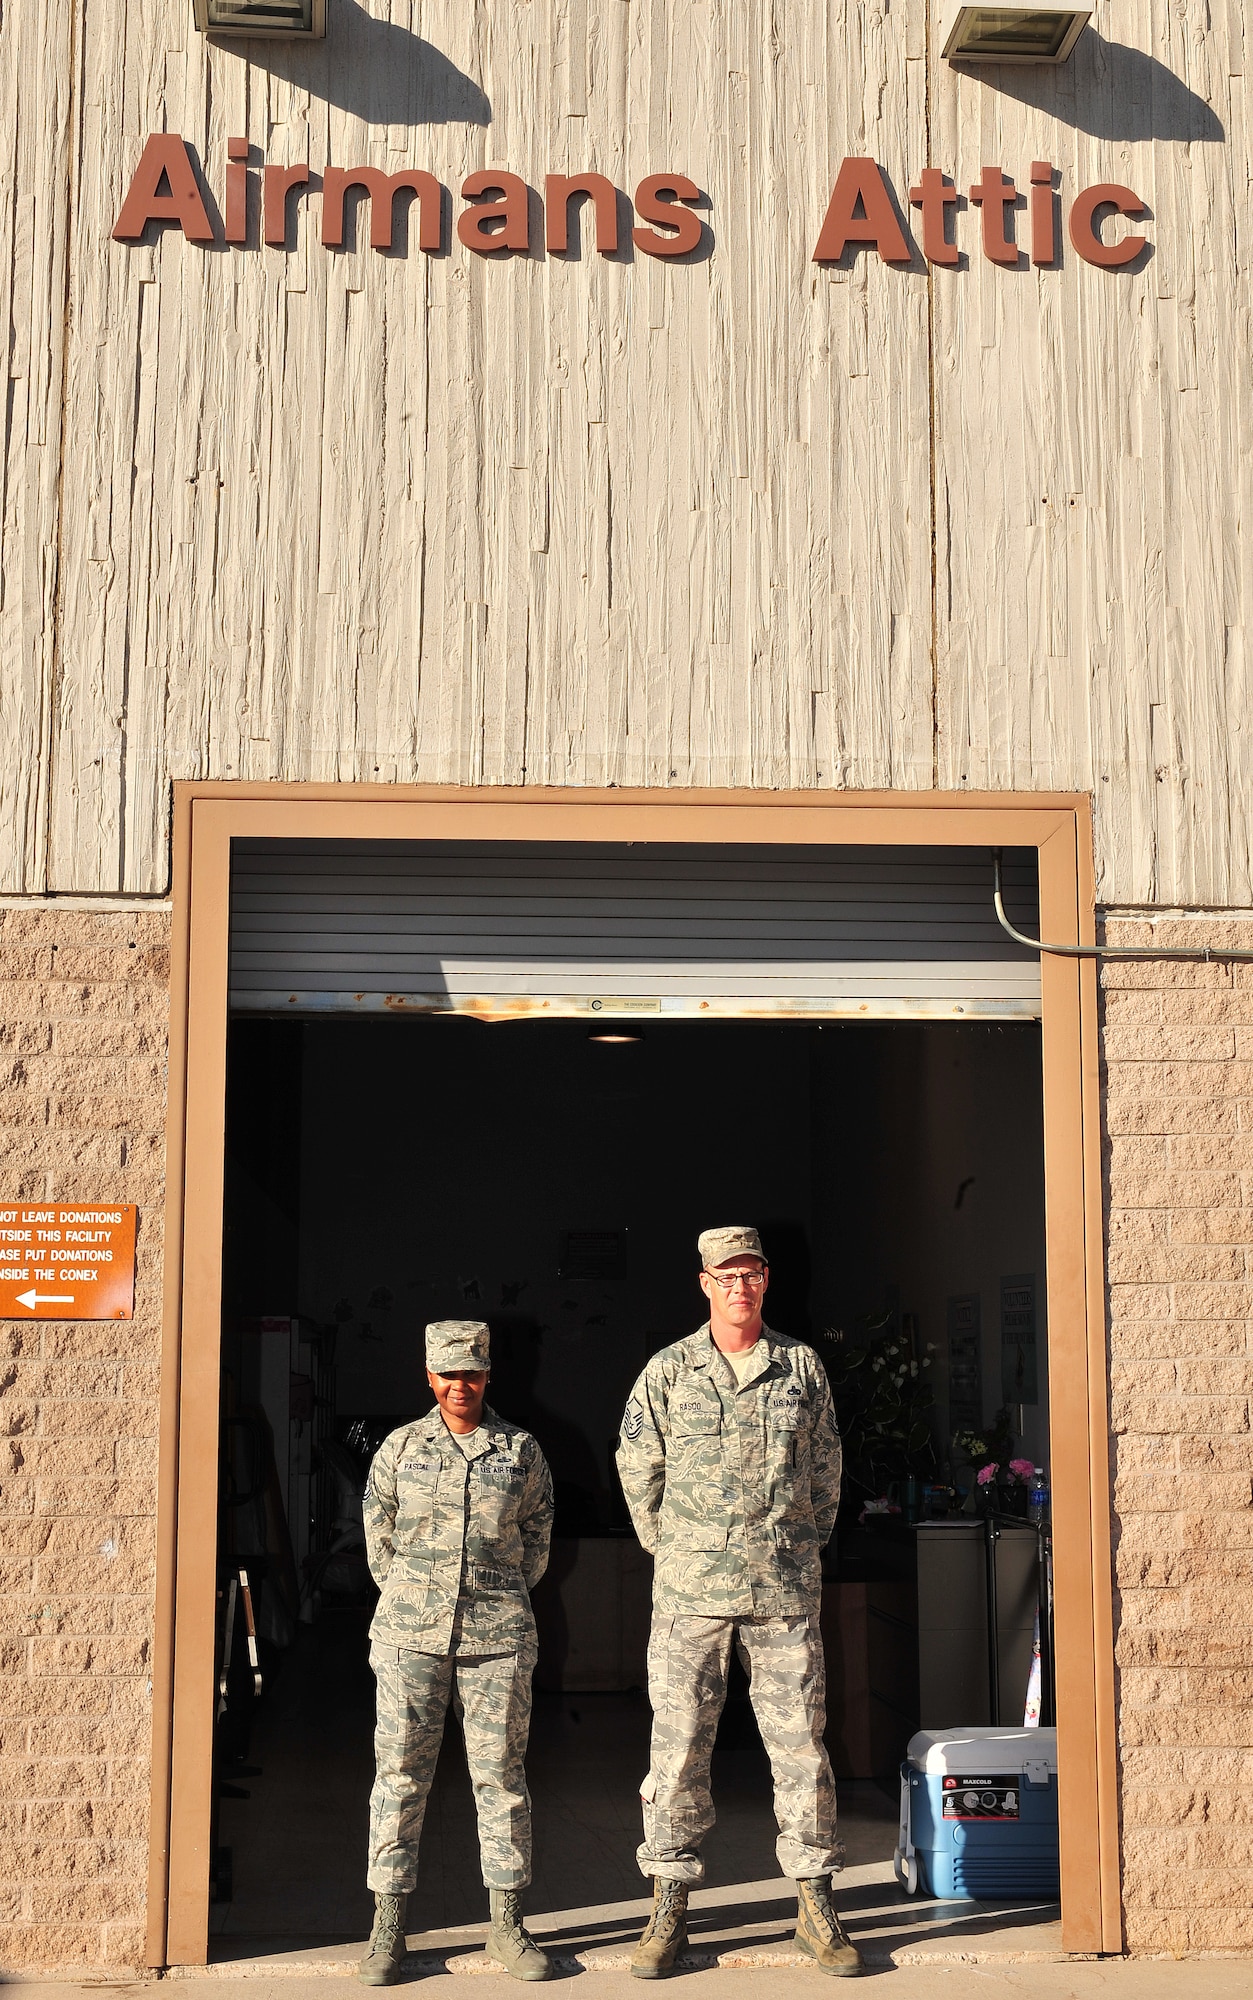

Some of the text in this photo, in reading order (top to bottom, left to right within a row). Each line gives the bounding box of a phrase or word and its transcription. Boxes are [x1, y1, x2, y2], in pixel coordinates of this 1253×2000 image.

[112, 133, 1146, 266] Airmans Attic
[22, 1211, 55, 1222] LEAVE
[60, 1211, 122, 1223] DONATIONS
[0, 1229, 111, 1242] TSIDE THIS FACILITY
[25, 1249, 46, 1261] PUT
[51, 1250, 113, 1262] DONATIONS
[34, 1269, 55, 1280] THE
[60, 1269, 98, 1280] CONEX
[404, 1463, 429, 1471] PASCAL
[945, 1796, 955, 1808] 5
